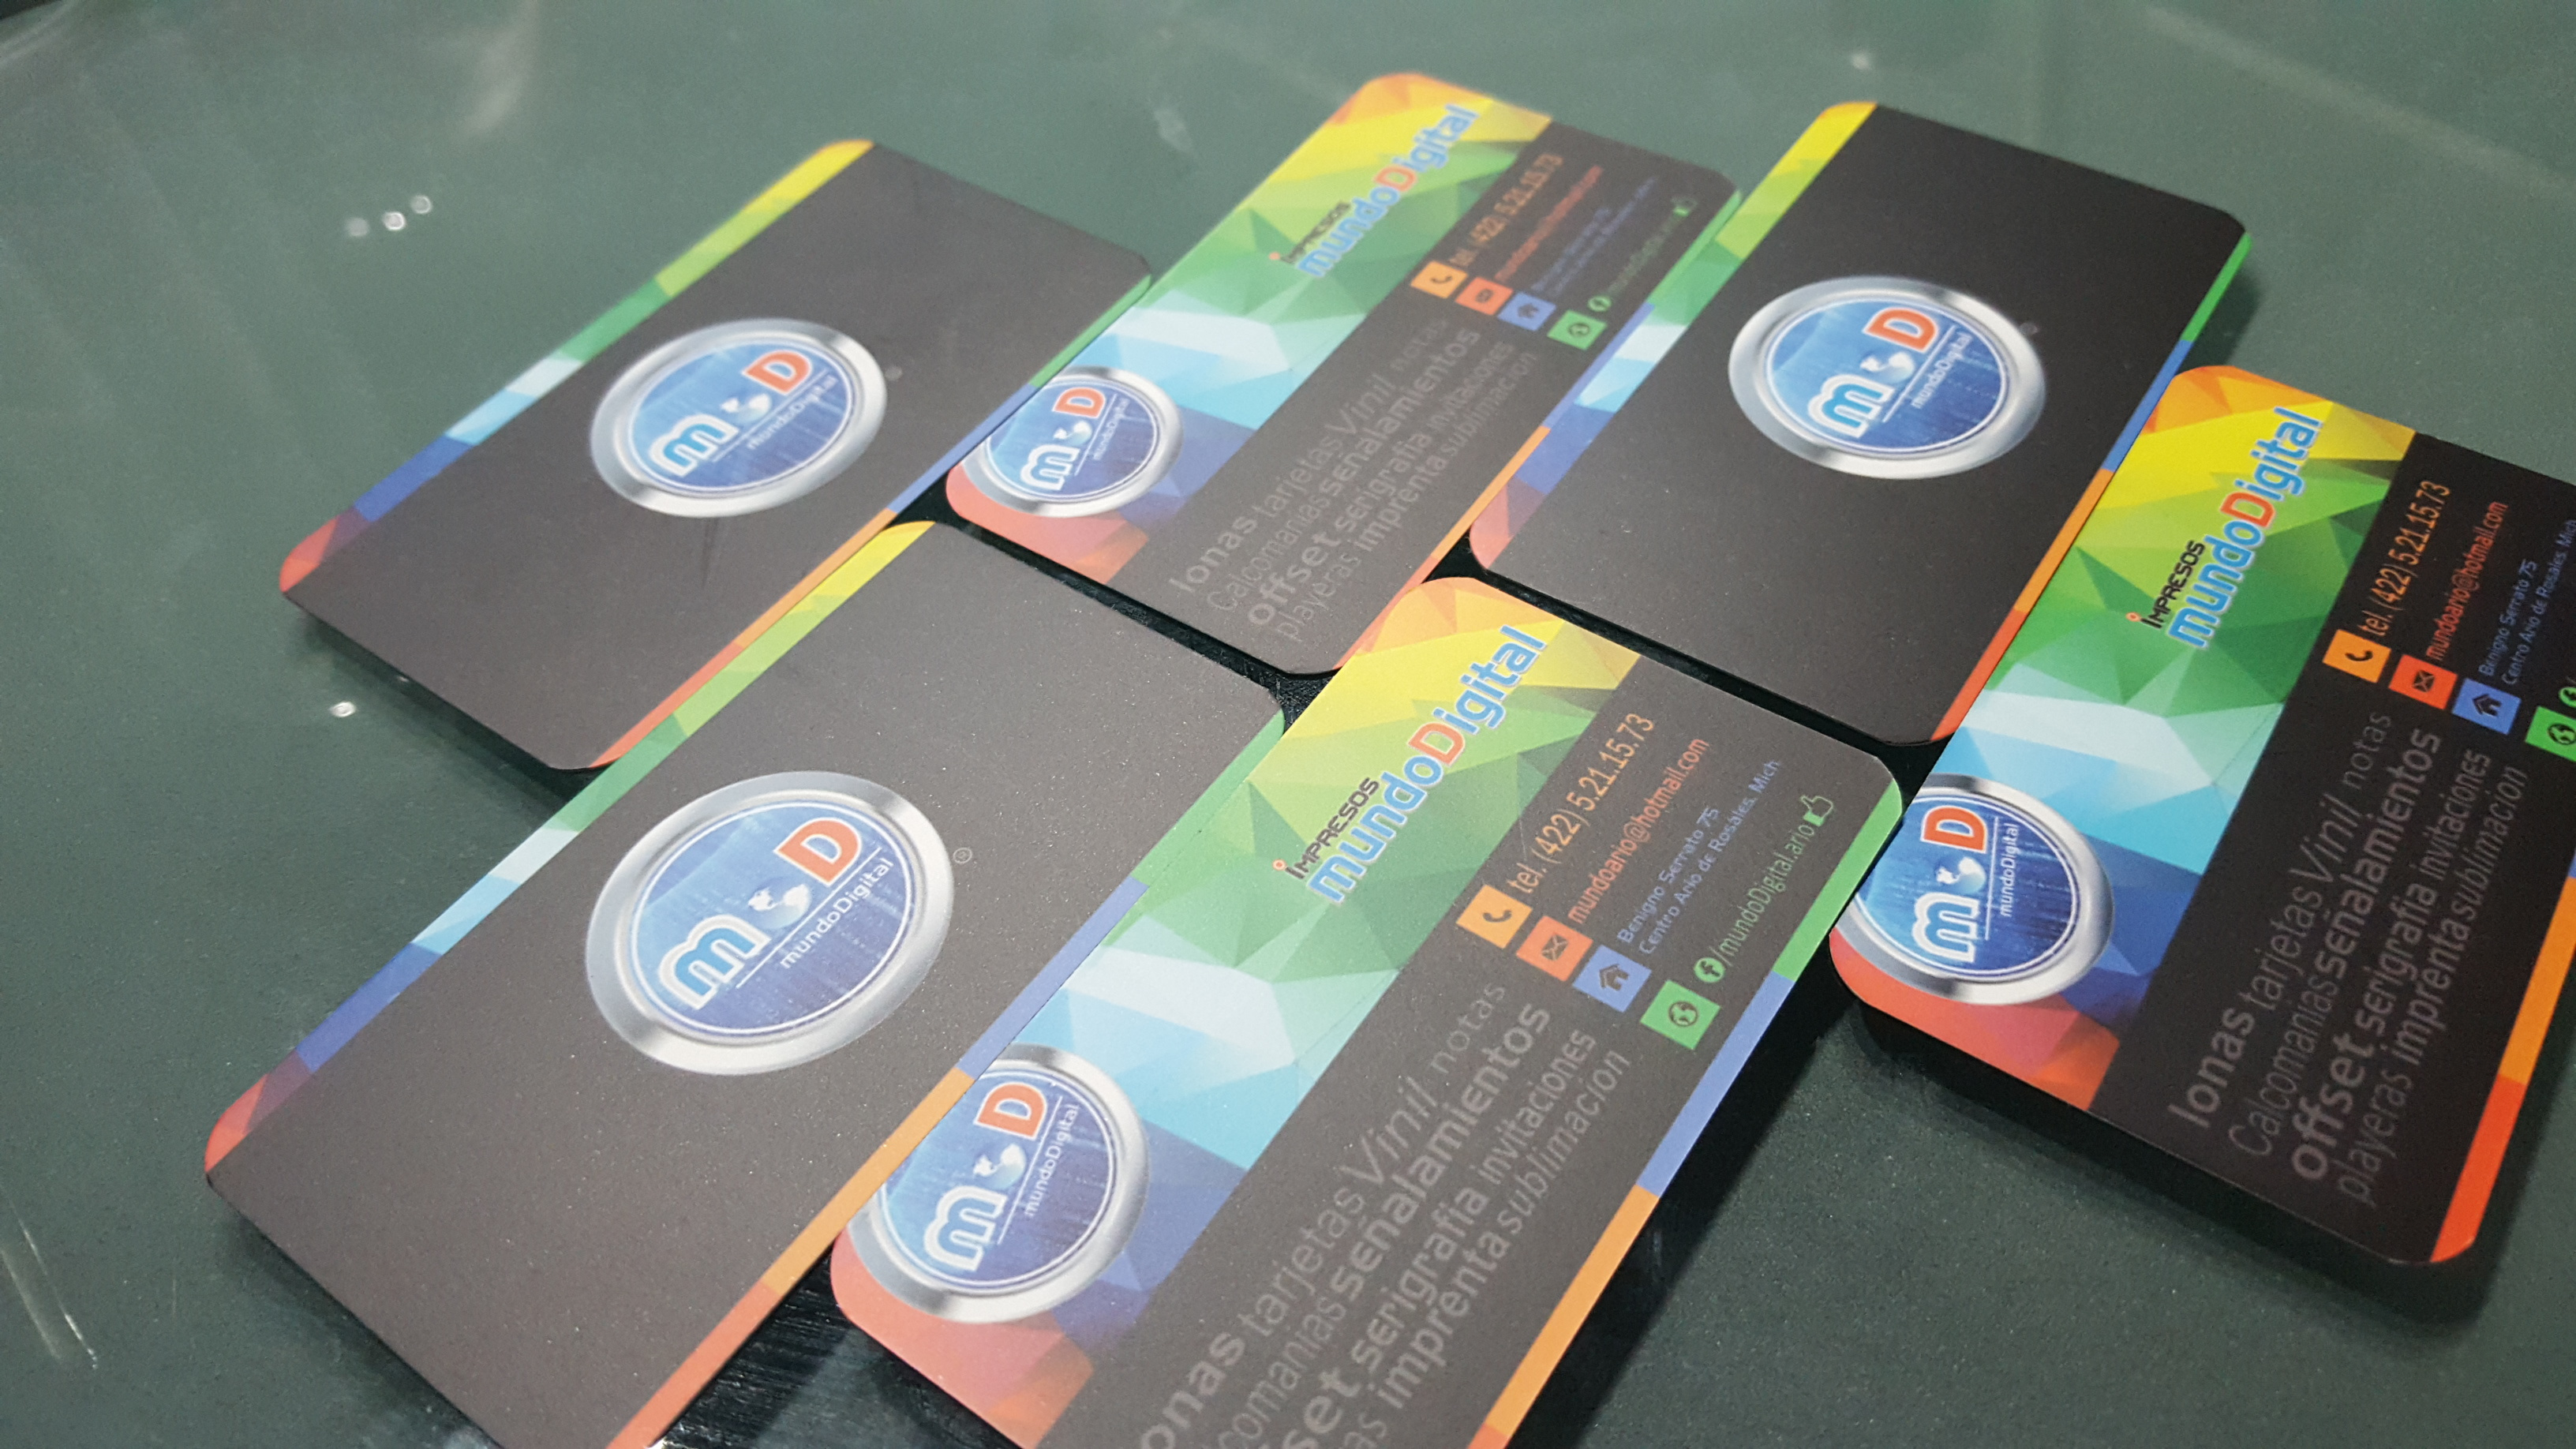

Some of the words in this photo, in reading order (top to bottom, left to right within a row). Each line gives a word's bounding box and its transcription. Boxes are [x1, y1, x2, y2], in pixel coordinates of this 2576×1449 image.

[1296, 103, 1480, 277] mundoDigital
[1168, 517, 1257, 592] lonas
[1252, 436, 1342, 518] tarjetas
[1324, 373, 1396, 434] Vinil
[1275, 552, 1361, 642] playeras
[1347, 454, 1448, 553] imprenta
[2166, 406, 2323, 648] mundoDigital
[2388, 480, 2450, 567] 5.21.15.73
[1248, 530, 1342, 624] offset
[2357, 609, 2394, 636] tel.
[2368, 563, 2418, 612] (422)
[2425, 500, 2509, 661] mundoario@hotmail.com
[1306, 623, 1548, 904] mundoDigital
[1505, 862, 1547, 894] tel.
[1530, 808, 1590, 864] (422)
[1566, 713, 1654, 812] 5.21.15.73
[1567, 737, 1709, 925] mundoario@hotmail.com
[1638, 905, 1681, 954] Centro
[1698, 853, 1716, 871] de
[1748, 760, 1782, 794] Mich
[2313, 728, 2441, 980] señalamientos
[780, 858, 894, 971] mundoDigital
[1616, 885, 1665, 943] Benigno
[1658, 829, 1704, 884] Serrato
[1696, 805, 1720, 828] 75
[2000, 822, 2020, 917] mundoDigital
[2167, 1008, 2255, 1129] lonas
[2238, 886, 2323, 1011] tarjetas
[2289, 792, 2362, 882] Vinil
[2342, 712, 2392, 790] notas
[2291, 1032, 2376, 1180] offset
[2409, 749, 2492, 881] invitaciones
[2337, 1069, 2413, 1208] playeras
[2379, 918, 2472, 1066] imprenta
[2451, 766, 2527, 922] sublimacion
[1024, 1103, 1081, 1219] mundoDigital
[1237, 1186, 1367, 1337] tarjetas
[1339, 1074, 1440, 1184] Vinil
[1428, 981, 1508, 1079] notas
[1329, 1002, 1551, 1302] señalamientos
[1468, 1028, 1597, 1185] invitaciones
[1368, 1229, 1511, 1410] imprenta
[1497, 1049, 1631, 1236] sublimacion
